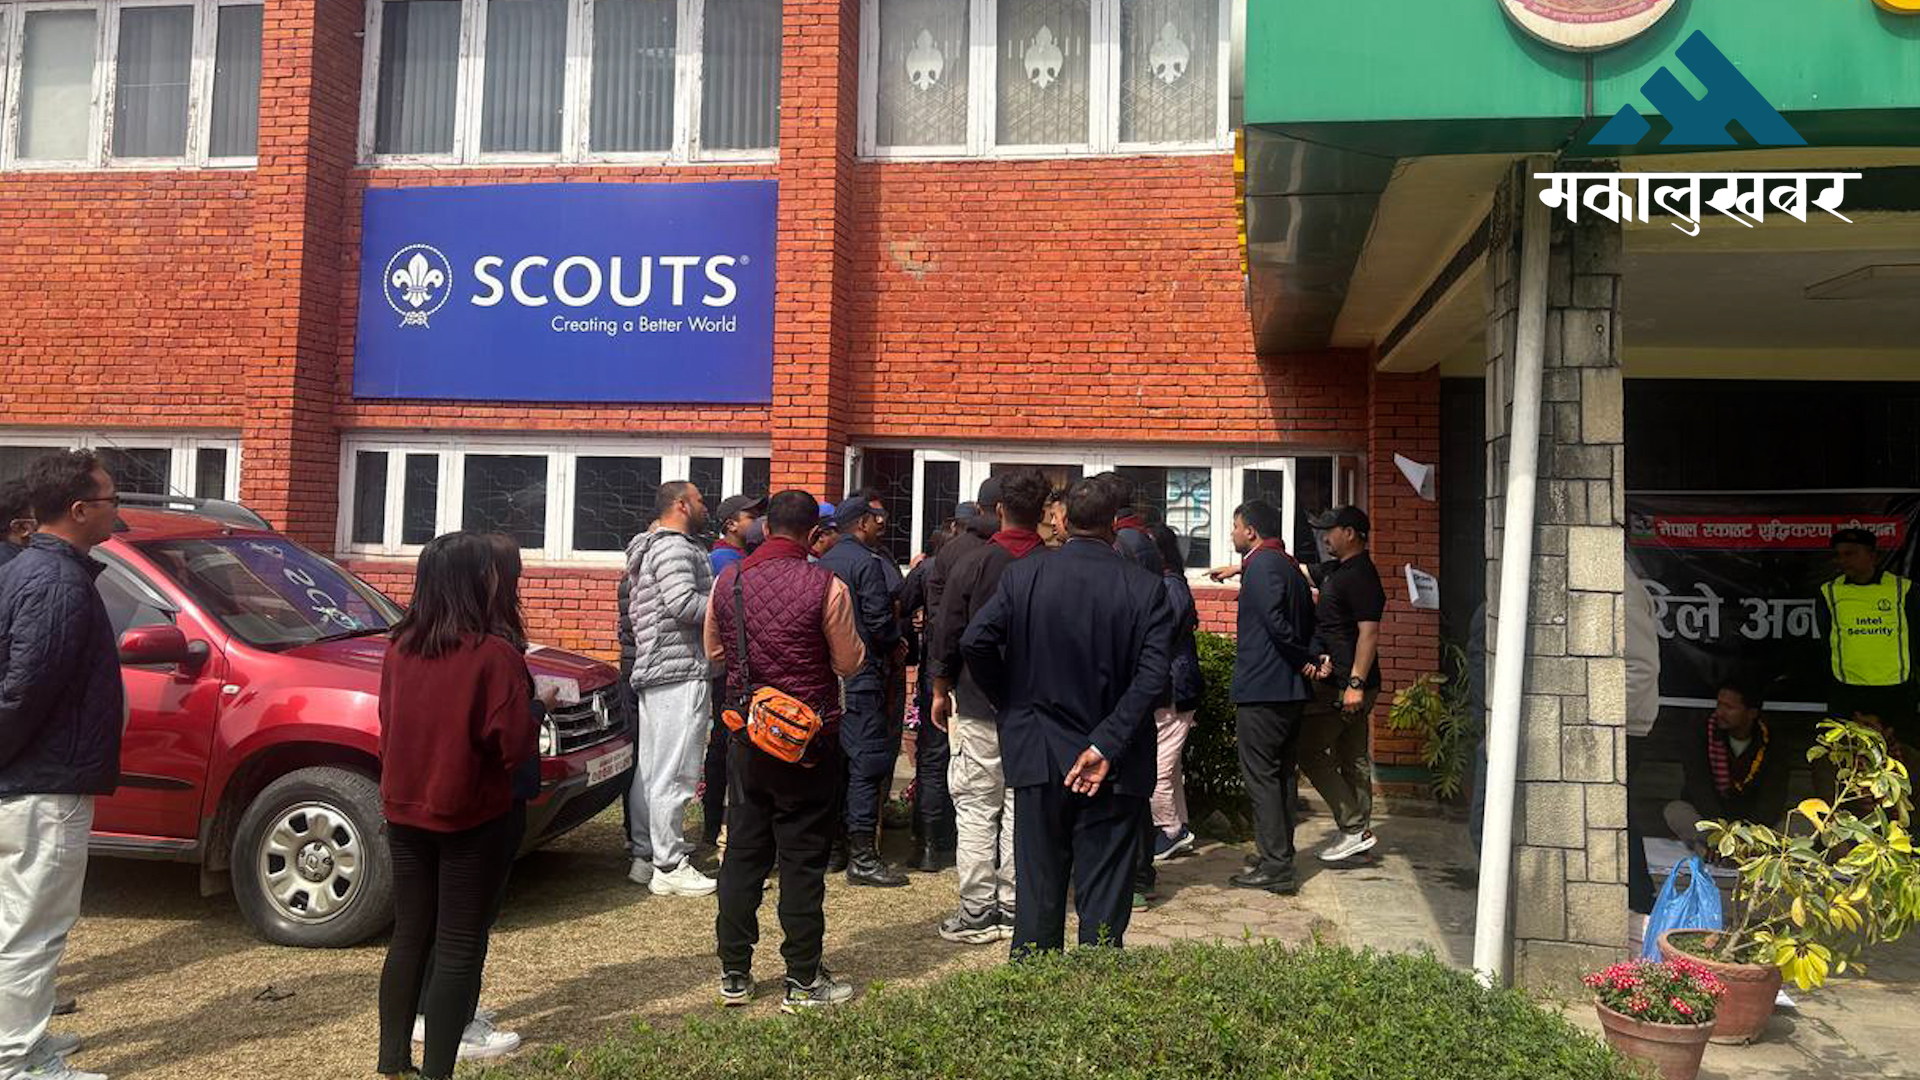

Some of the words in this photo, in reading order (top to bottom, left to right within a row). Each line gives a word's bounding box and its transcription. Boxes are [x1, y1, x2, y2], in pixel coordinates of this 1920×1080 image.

[471, 254, 738, 308] SCOUTS
[551, 316, 618, 337] Creating
[622, 320, 634, 334] a
[639, 316, 683, 334] Better
[687, 316, 737, 334] World
[1658, 519, 1697, 538] नेपाल
[1856, 616, 1882, 625] Intel
[1848, 627, 1893, 637] Security
